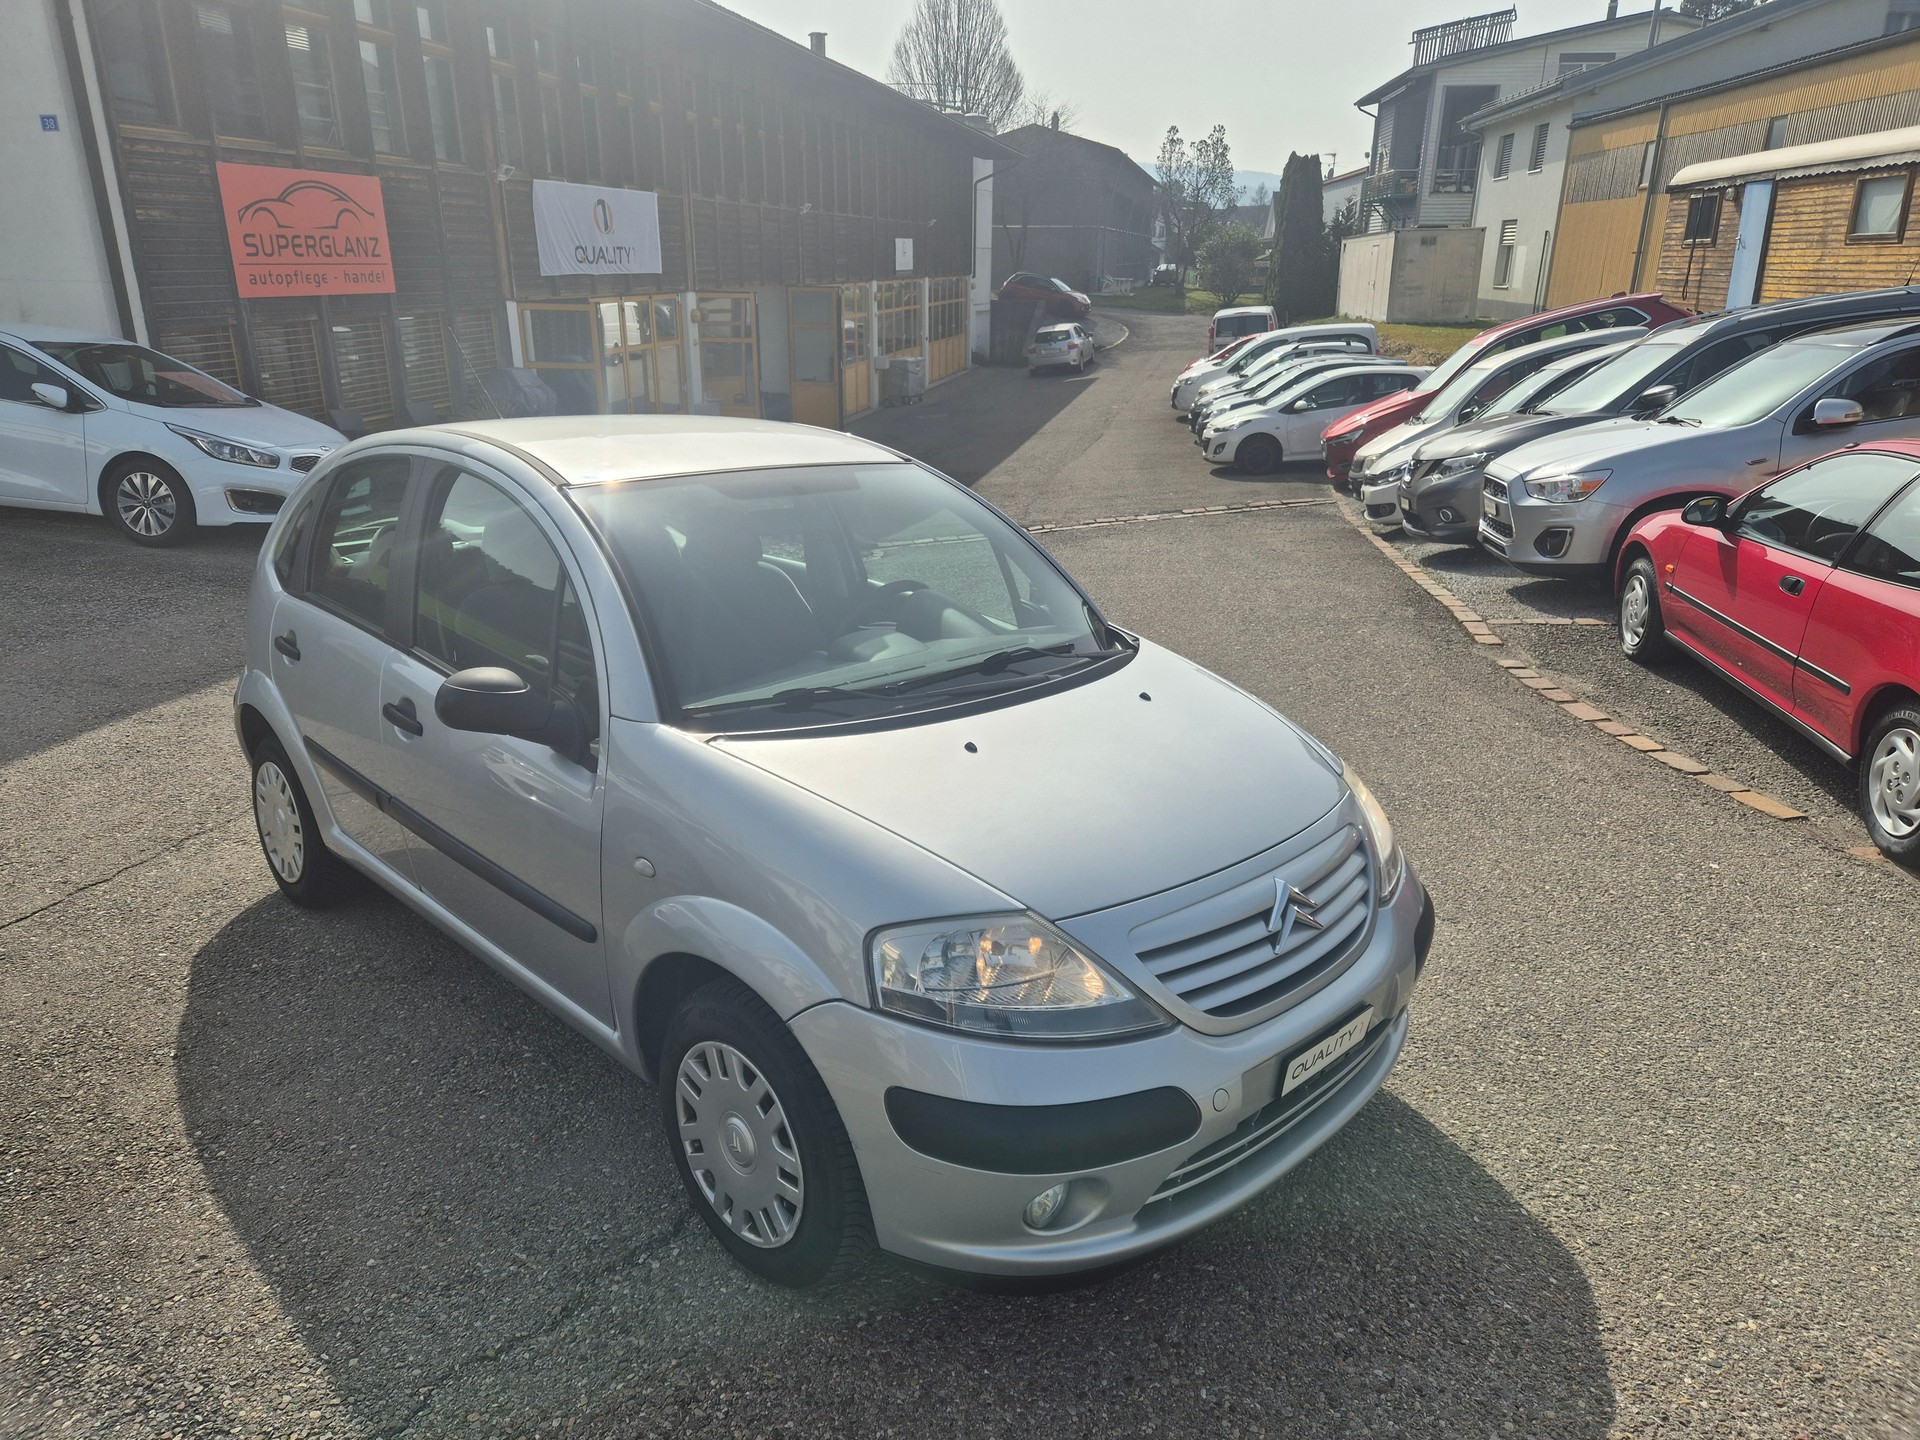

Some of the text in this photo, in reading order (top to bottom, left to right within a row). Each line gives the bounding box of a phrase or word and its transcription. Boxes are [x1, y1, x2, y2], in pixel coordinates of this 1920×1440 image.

[43, 118, 56, 129] 38
[243, 233, 382, 258] SUPERGLANZ
[250, 270, 329, 287] autopflege
[344, 270, 386, 284] handel
